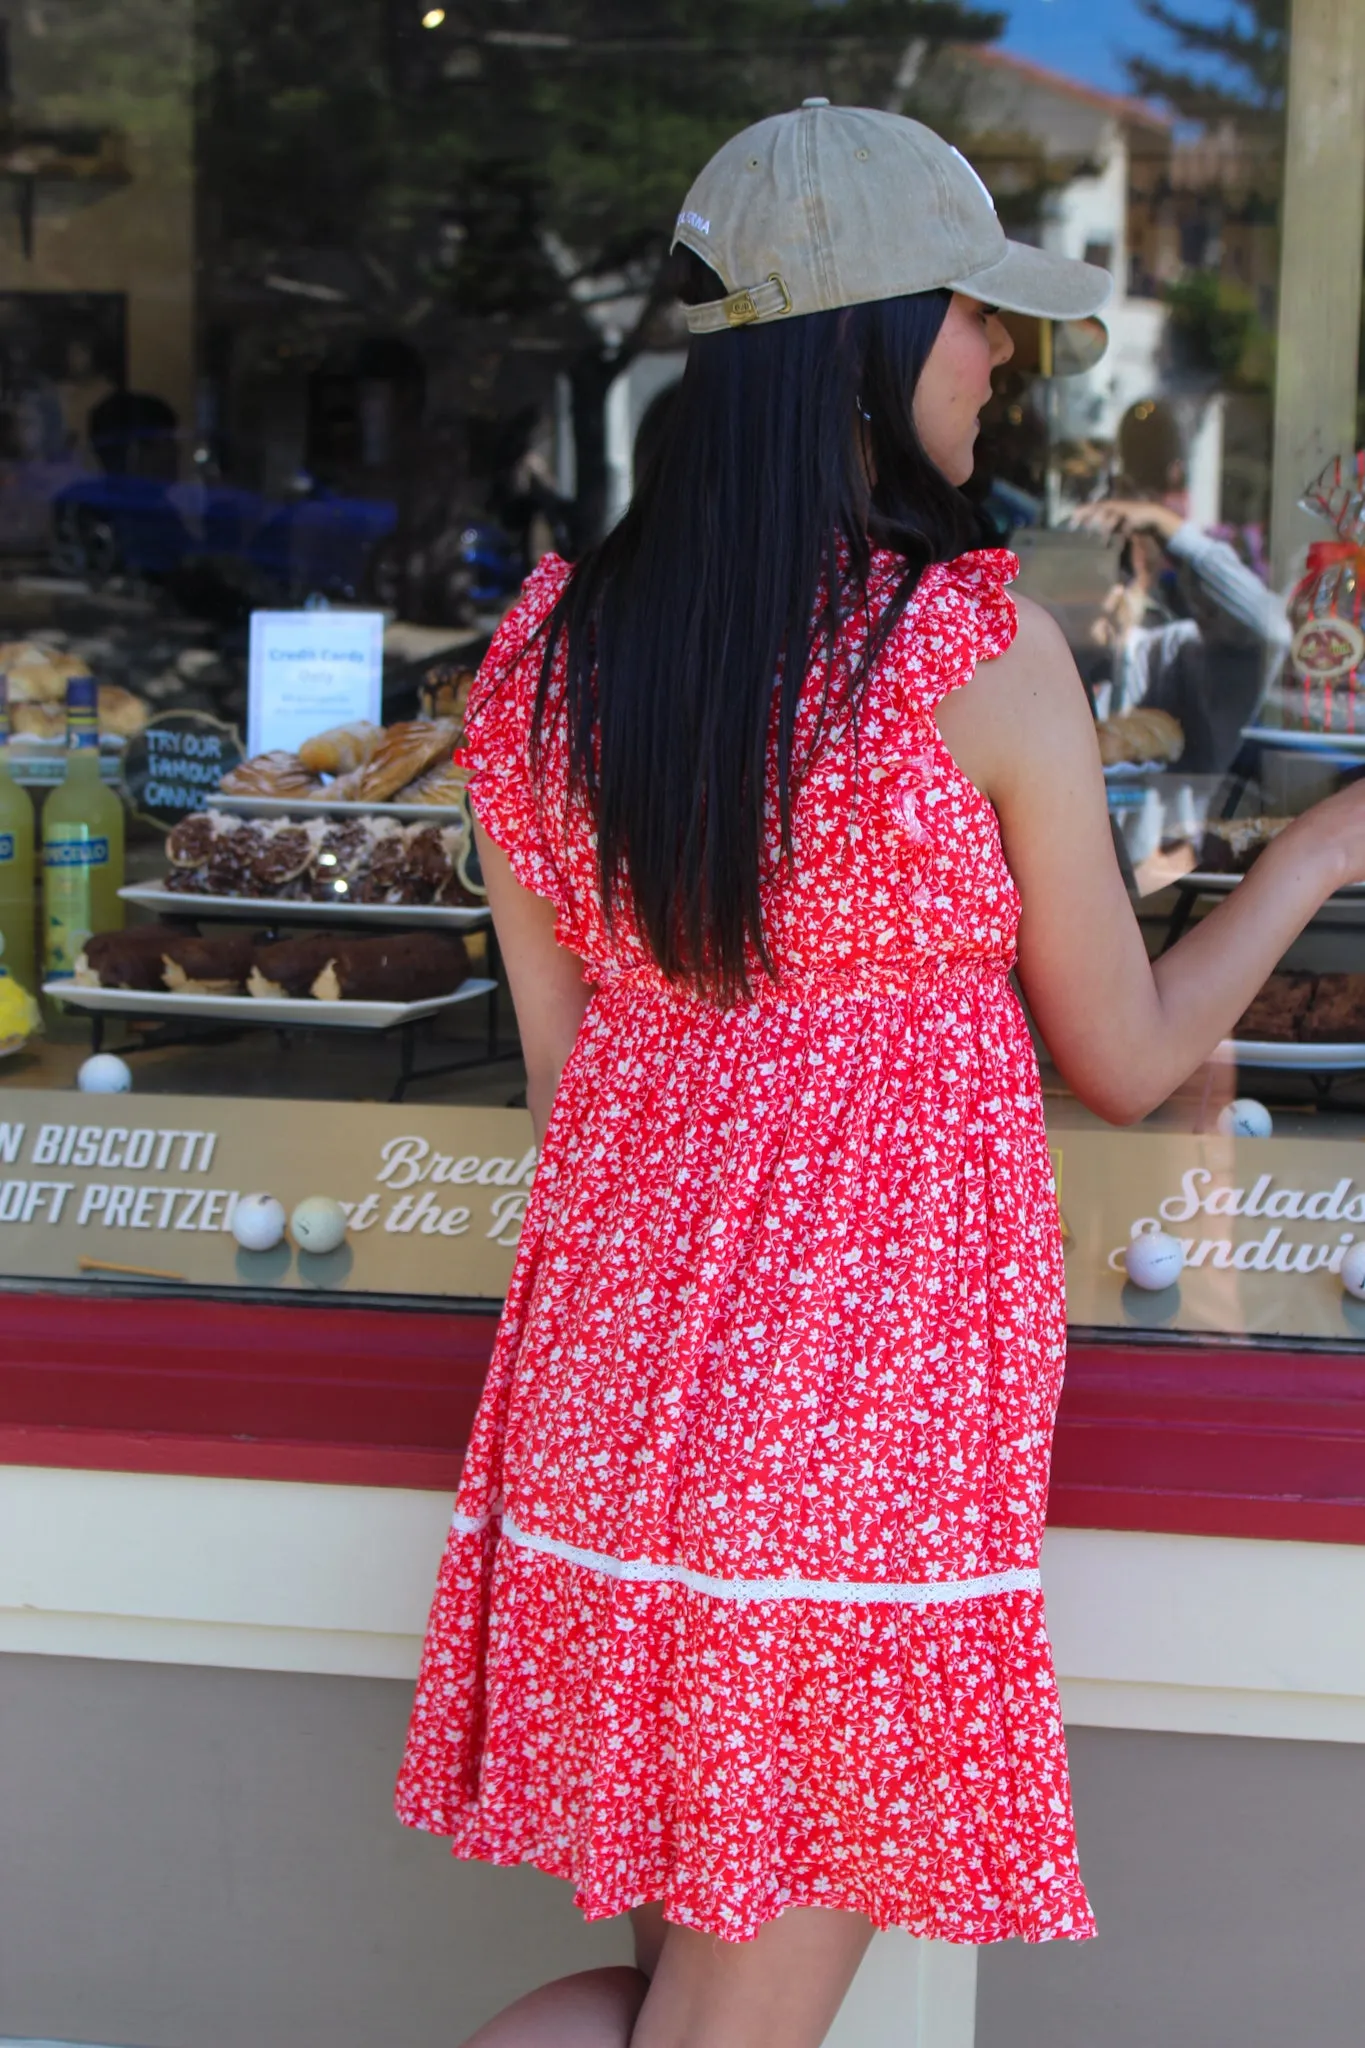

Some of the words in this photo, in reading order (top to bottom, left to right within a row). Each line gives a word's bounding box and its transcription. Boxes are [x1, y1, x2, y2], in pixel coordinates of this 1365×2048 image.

[146, 729, 180, 754] TRY
[183, 733, 222, 758] OUR
[149, 754, 223, 788] FAMOUS
[32, 1124, 217, 1171] BISCOTTI
[384, 1190, 471, 1236] the
[1159, 1168, 1365, 1223] Salads
